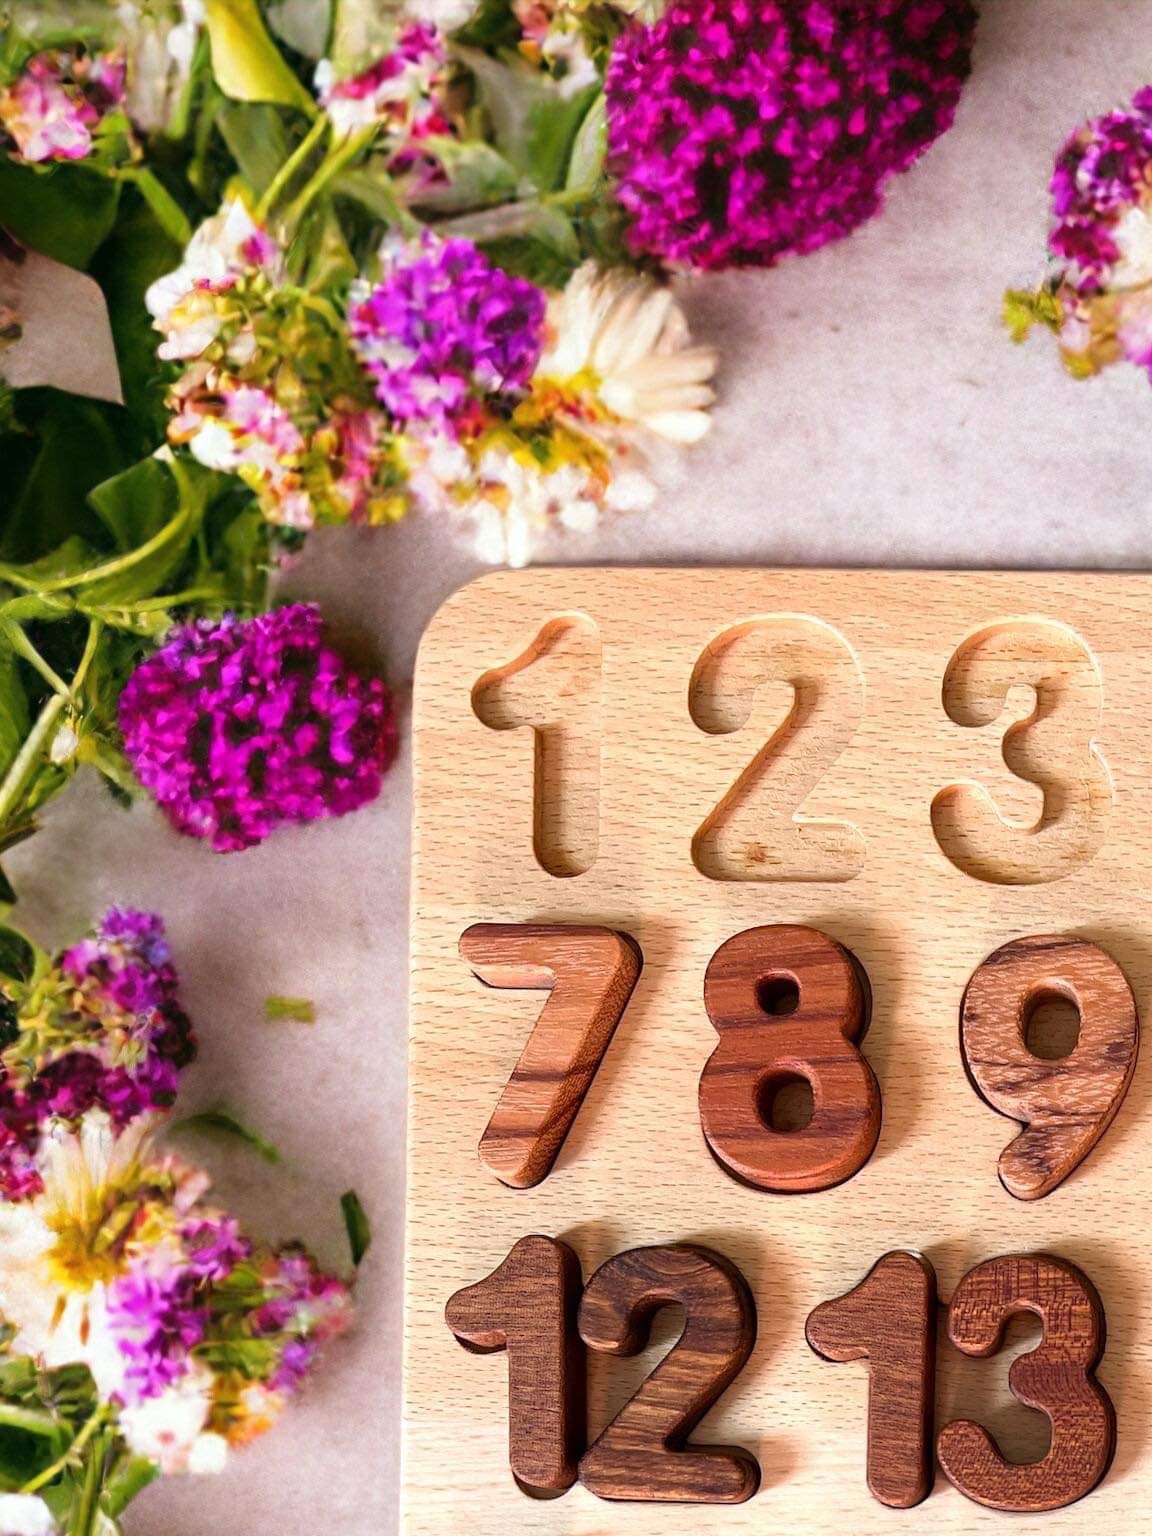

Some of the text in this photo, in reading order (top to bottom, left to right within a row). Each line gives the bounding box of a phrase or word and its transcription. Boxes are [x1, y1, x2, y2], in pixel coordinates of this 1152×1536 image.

[471, 611, 602, 878] 1
[688, 612, 867, 882] 2
[930, 615, 1116, 885] 3
[458, 923, 643, 1189] 7
[699, 923, 882, 1195] 8
[959, 933, 1140, 1201] 9
[445, 1234, 761, 1504] 12
[805, 1249, 1117, 1512] 13
